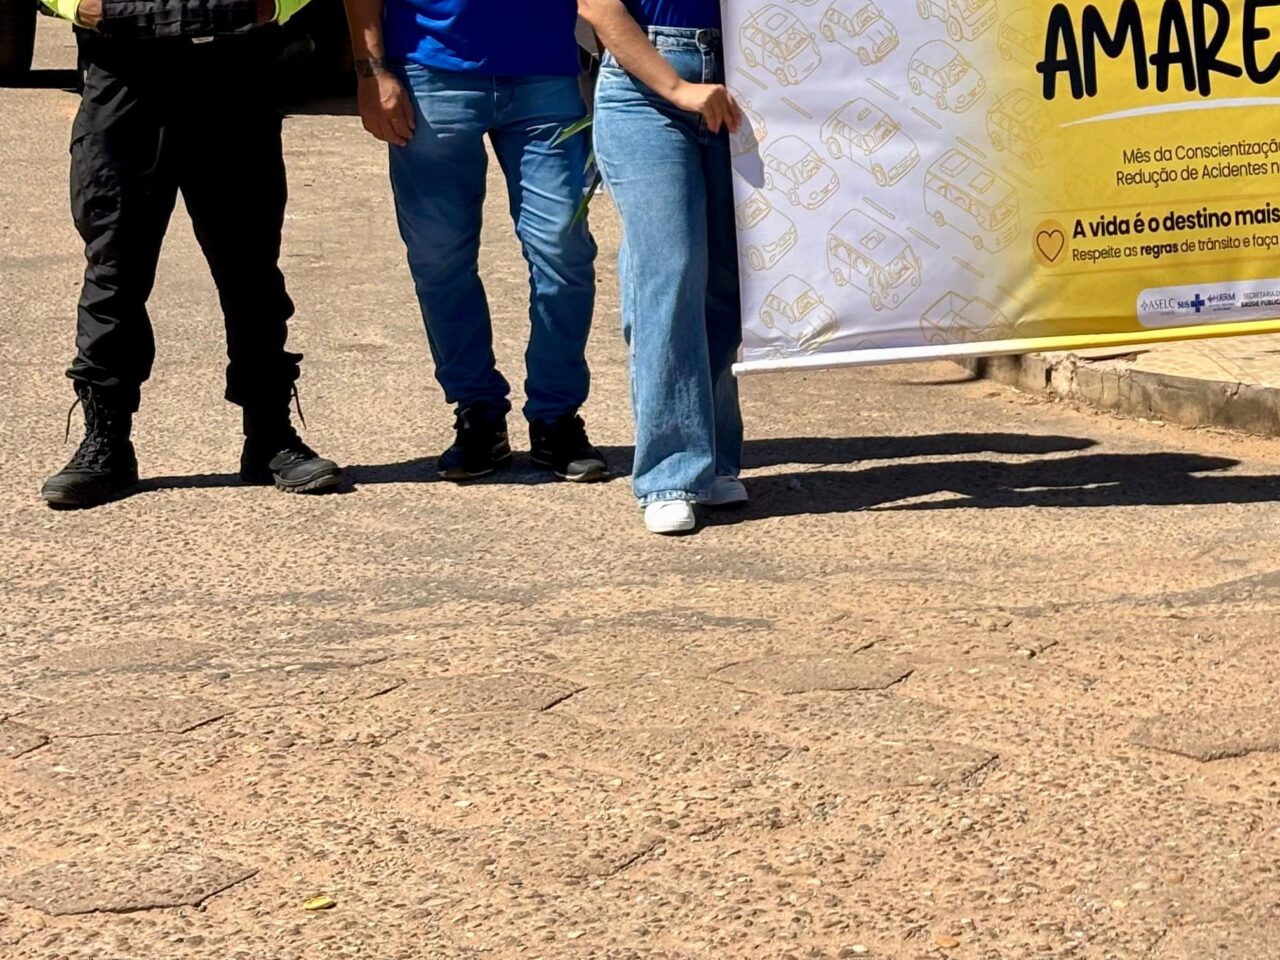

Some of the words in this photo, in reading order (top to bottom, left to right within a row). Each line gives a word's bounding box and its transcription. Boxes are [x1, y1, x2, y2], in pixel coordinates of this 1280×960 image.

[1123, 148, 1151, 164] Mês
[1154, 146, 1172, 162] da
[1116, 167, 1178, 188] Redução
[1180, 165, 1199, 181] de
[1202, 162, 1268, 180] Acidentes
[1072, 219, 1087, 239] A
[1089, 215, 1130, 237] vida
[1133, 212, 1145, 234] é
[1148, 217, 1160, 233] o
[1162, 207, 1232, 231] destino
[1235, 202, 1280, 226] mais
[1072, 245, 1122, 264] Respeite
[1124, 246, 1138, 257] as
[1140, 243, 1178, 259] regras
[1180, 240, 1196, 252] de
[1198, 235, 1241, 251] trânsito
[1243, 238, 1251, 248] e
[1252, 234, 1279, 250] faça
[1148, 298, 1176, 310] ASELC
[1177, 300, 1190, 309] SUS
[1243, 291, 1274, 300] SECRETARIA
